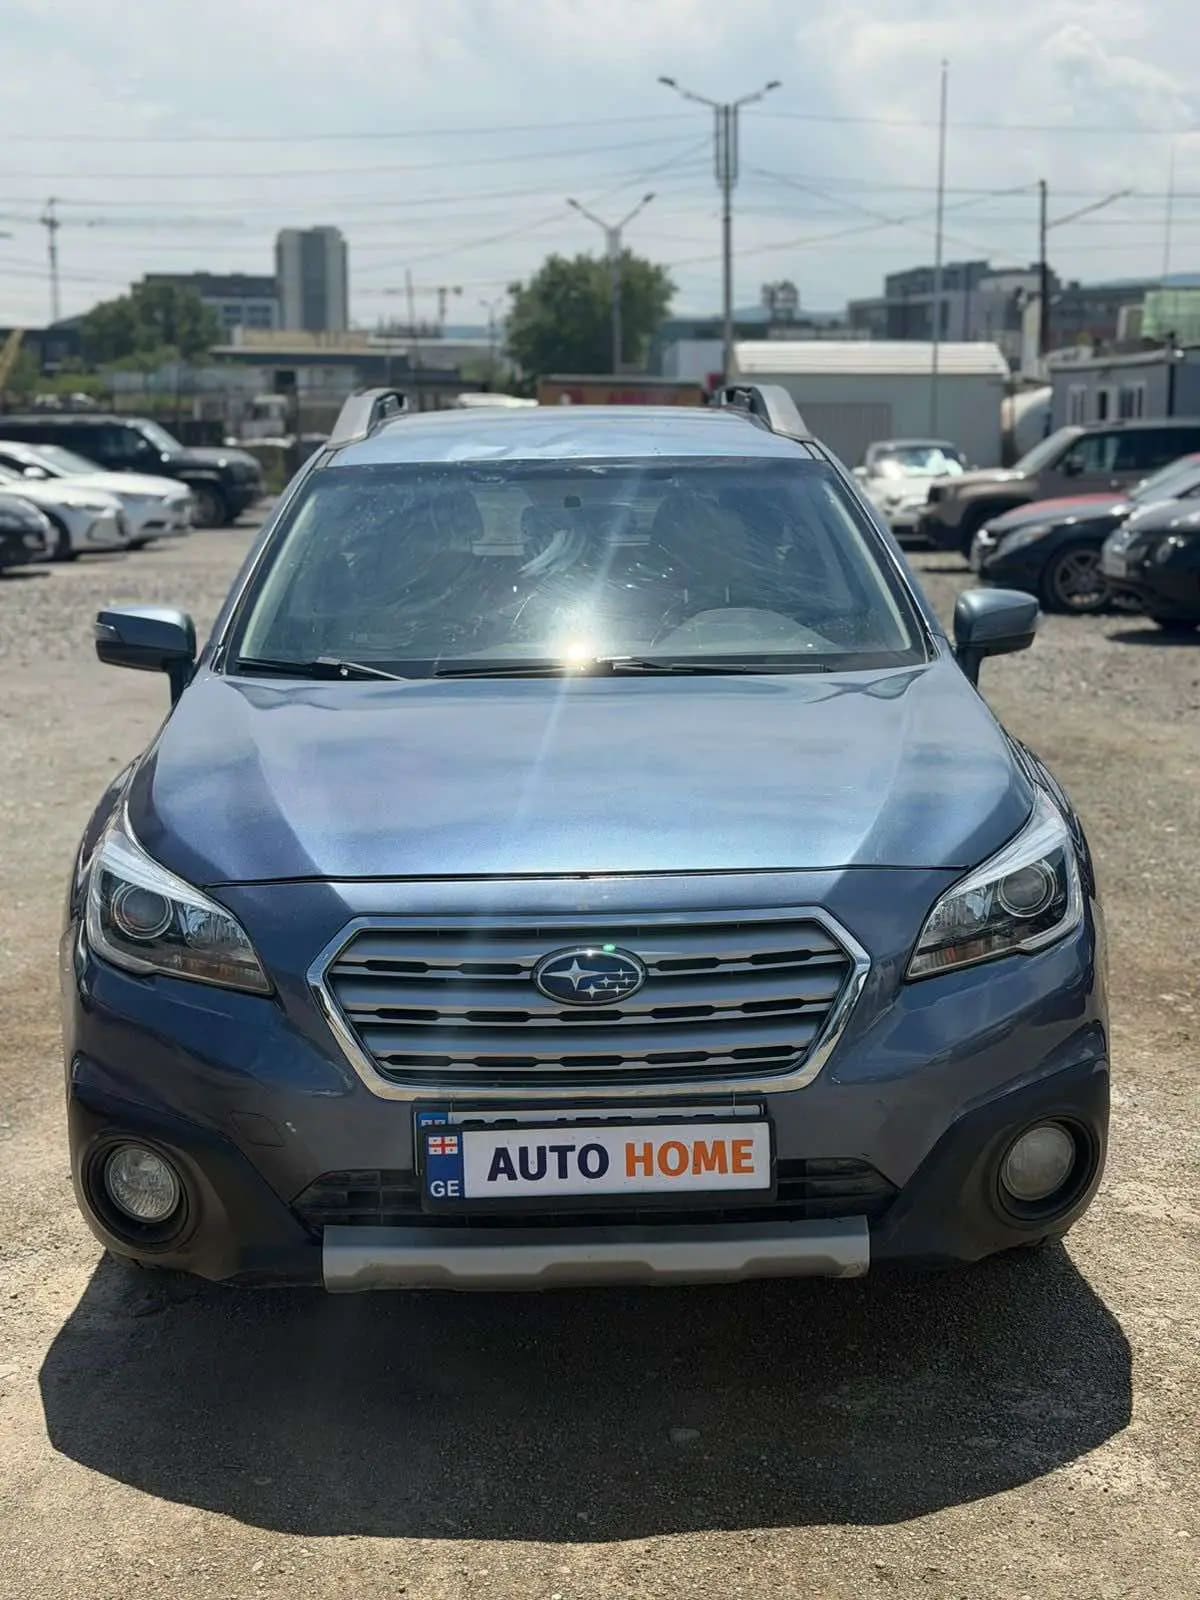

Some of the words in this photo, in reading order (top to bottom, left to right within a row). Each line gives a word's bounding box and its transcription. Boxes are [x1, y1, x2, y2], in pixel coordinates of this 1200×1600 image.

[487, 1143, 610, 1182] AUTO
[625, 1139, 755, 1178] HOME
[430, 1180, 460, 1198] GE
